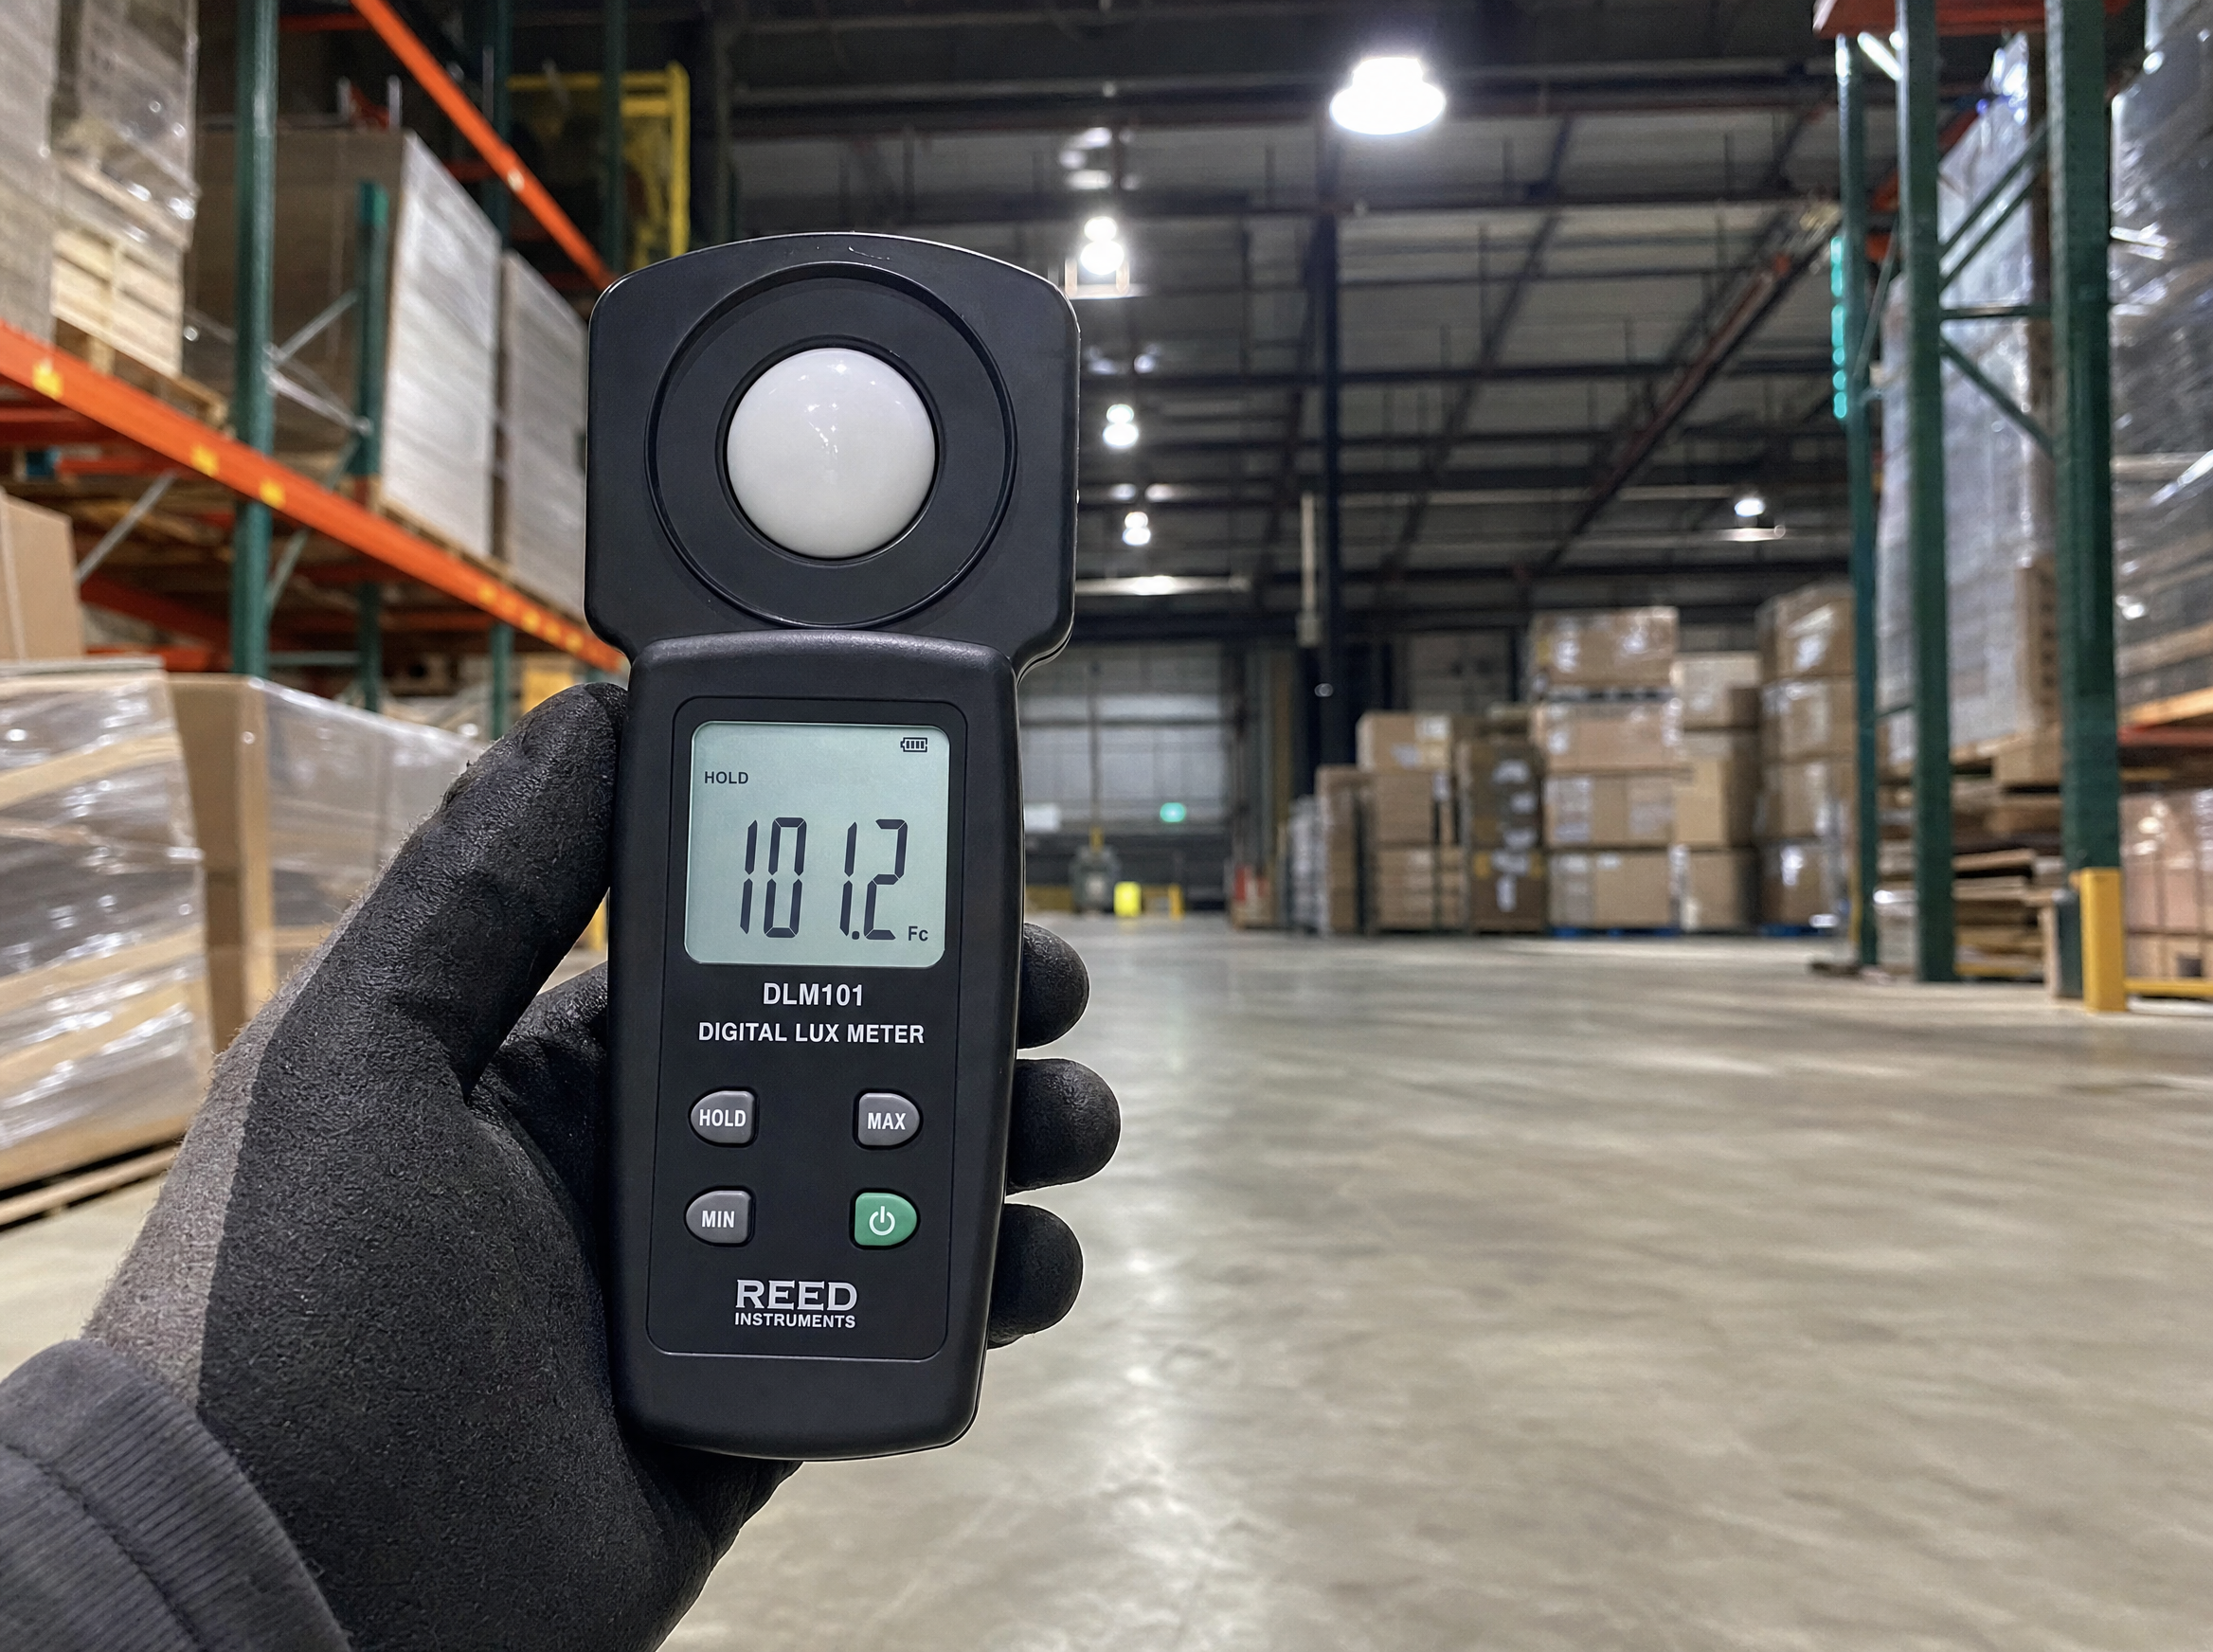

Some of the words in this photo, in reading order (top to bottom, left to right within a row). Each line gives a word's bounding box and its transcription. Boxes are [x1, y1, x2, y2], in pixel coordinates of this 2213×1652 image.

[704, 770, 749, 784] HOLD
[739, 817, 909, 941] 101.2
[908, 925, 928, 942] Fc
[763, 982, 862, 1007] DLM101
[698, 1022, 788, 1042] DIGITAL
[795, 1023, 839, 1043] LUX
[847, 1023, 925, 1044] METER
[698, 1107, 747, 1128] HOLD
[867, 1112, 907, 1130] MAX
[701, 1210, 735, 1229] MIN
[735, 1279, 857, 1311] REED
[734, 1312, 855, 1329] INSTRUMENTS
